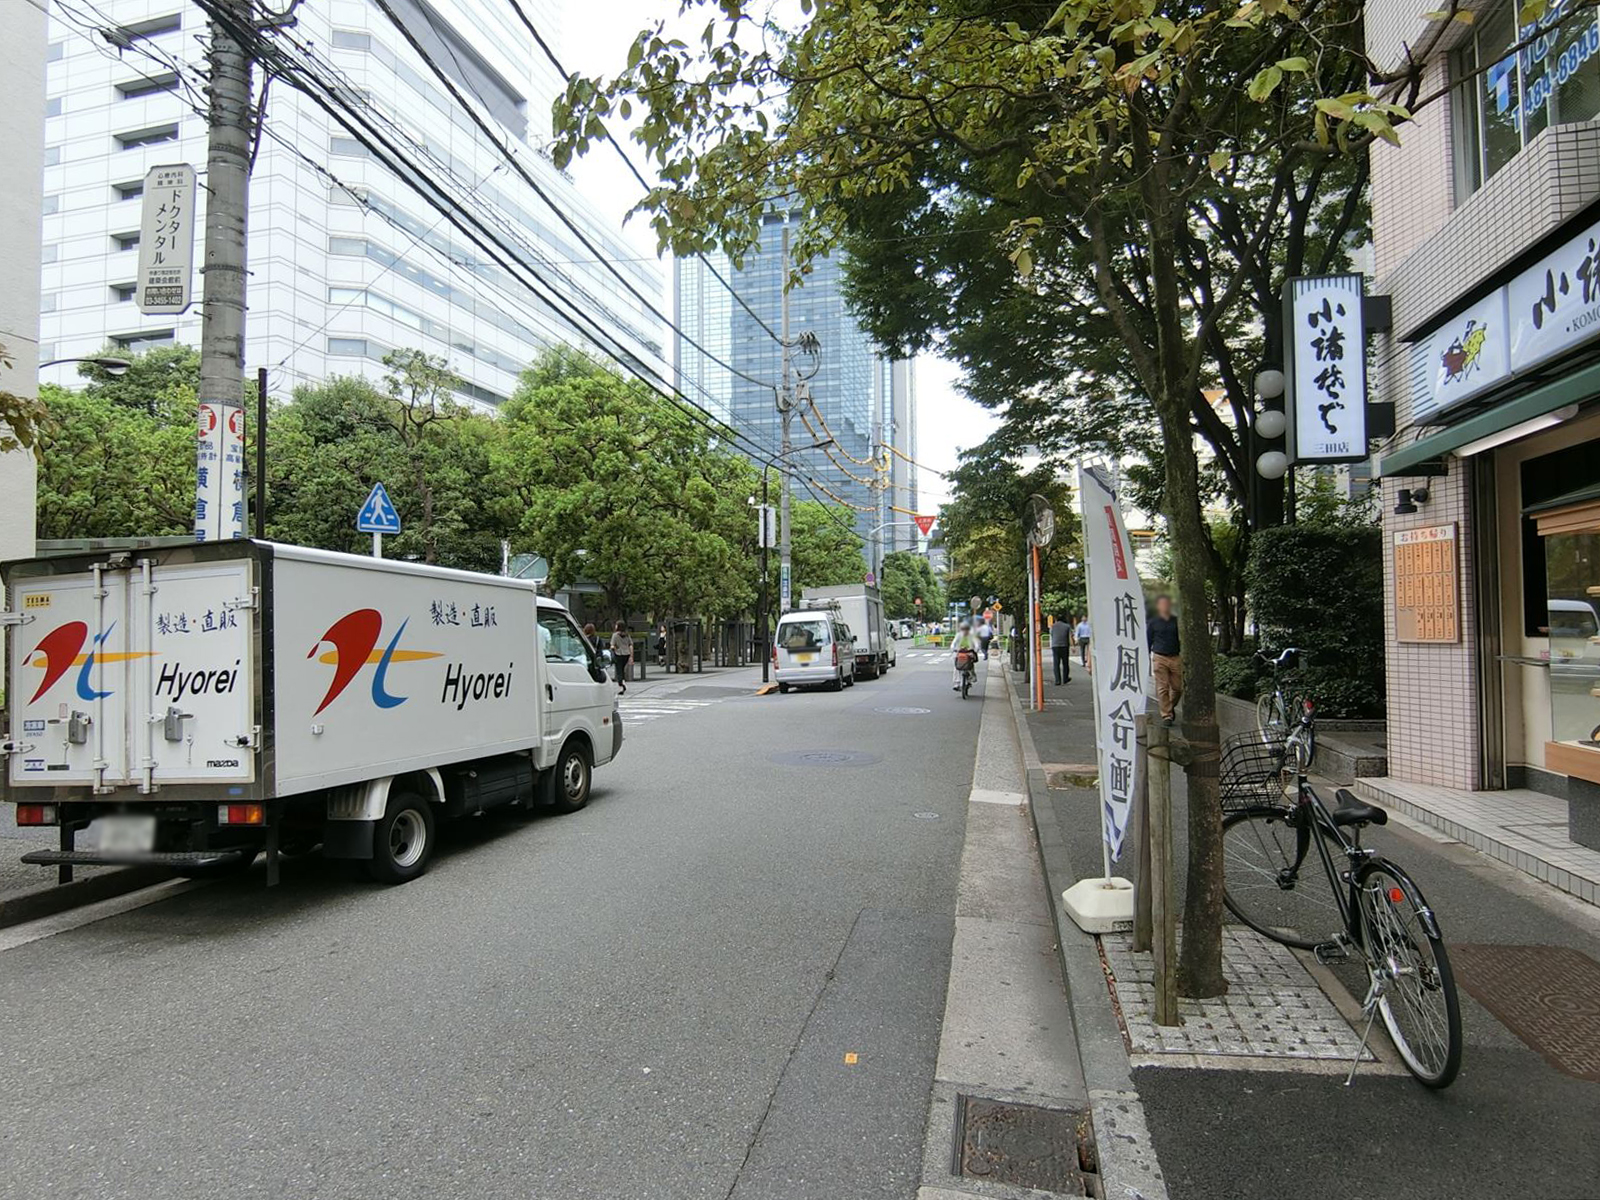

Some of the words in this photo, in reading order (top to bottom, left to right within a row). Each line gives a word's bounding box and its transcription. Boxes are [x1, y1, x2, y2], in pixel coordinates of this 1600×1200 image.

[153, 203, 168, 265] メンタル
[169, 189, 182, 250] ドクター
[1314, 442, 1350, 454] 三田店
[155, 658, 242, 703] Hyorei
[441, 661, 514, 711] Hyorei
